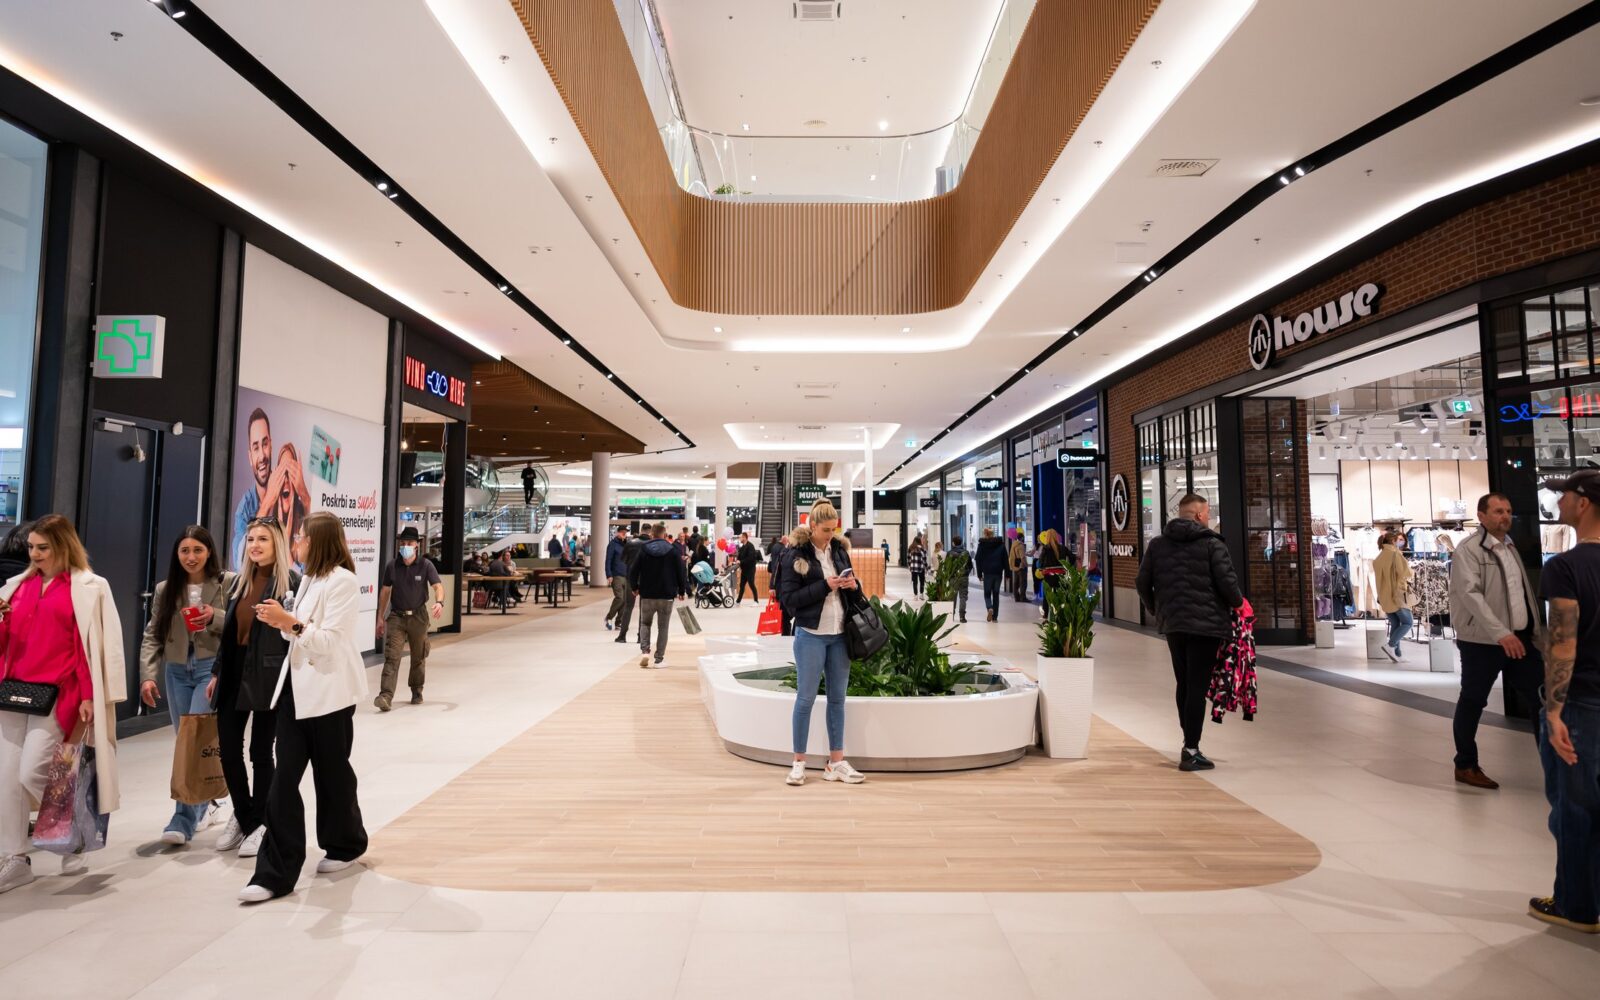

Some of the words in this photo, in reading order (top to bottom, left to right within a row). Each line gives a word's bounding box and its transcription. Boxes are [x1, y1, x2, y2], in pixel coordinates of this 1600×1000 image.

[1274, 282, 1381, 351] house
[406, 355, 426, 391] VINO
[449, 376, 466, 407] RIBE
[321, 492, 347, 509] Poskrbi
[349, 498, 357, 509] za
[1108, 541, 1134, 557] house
